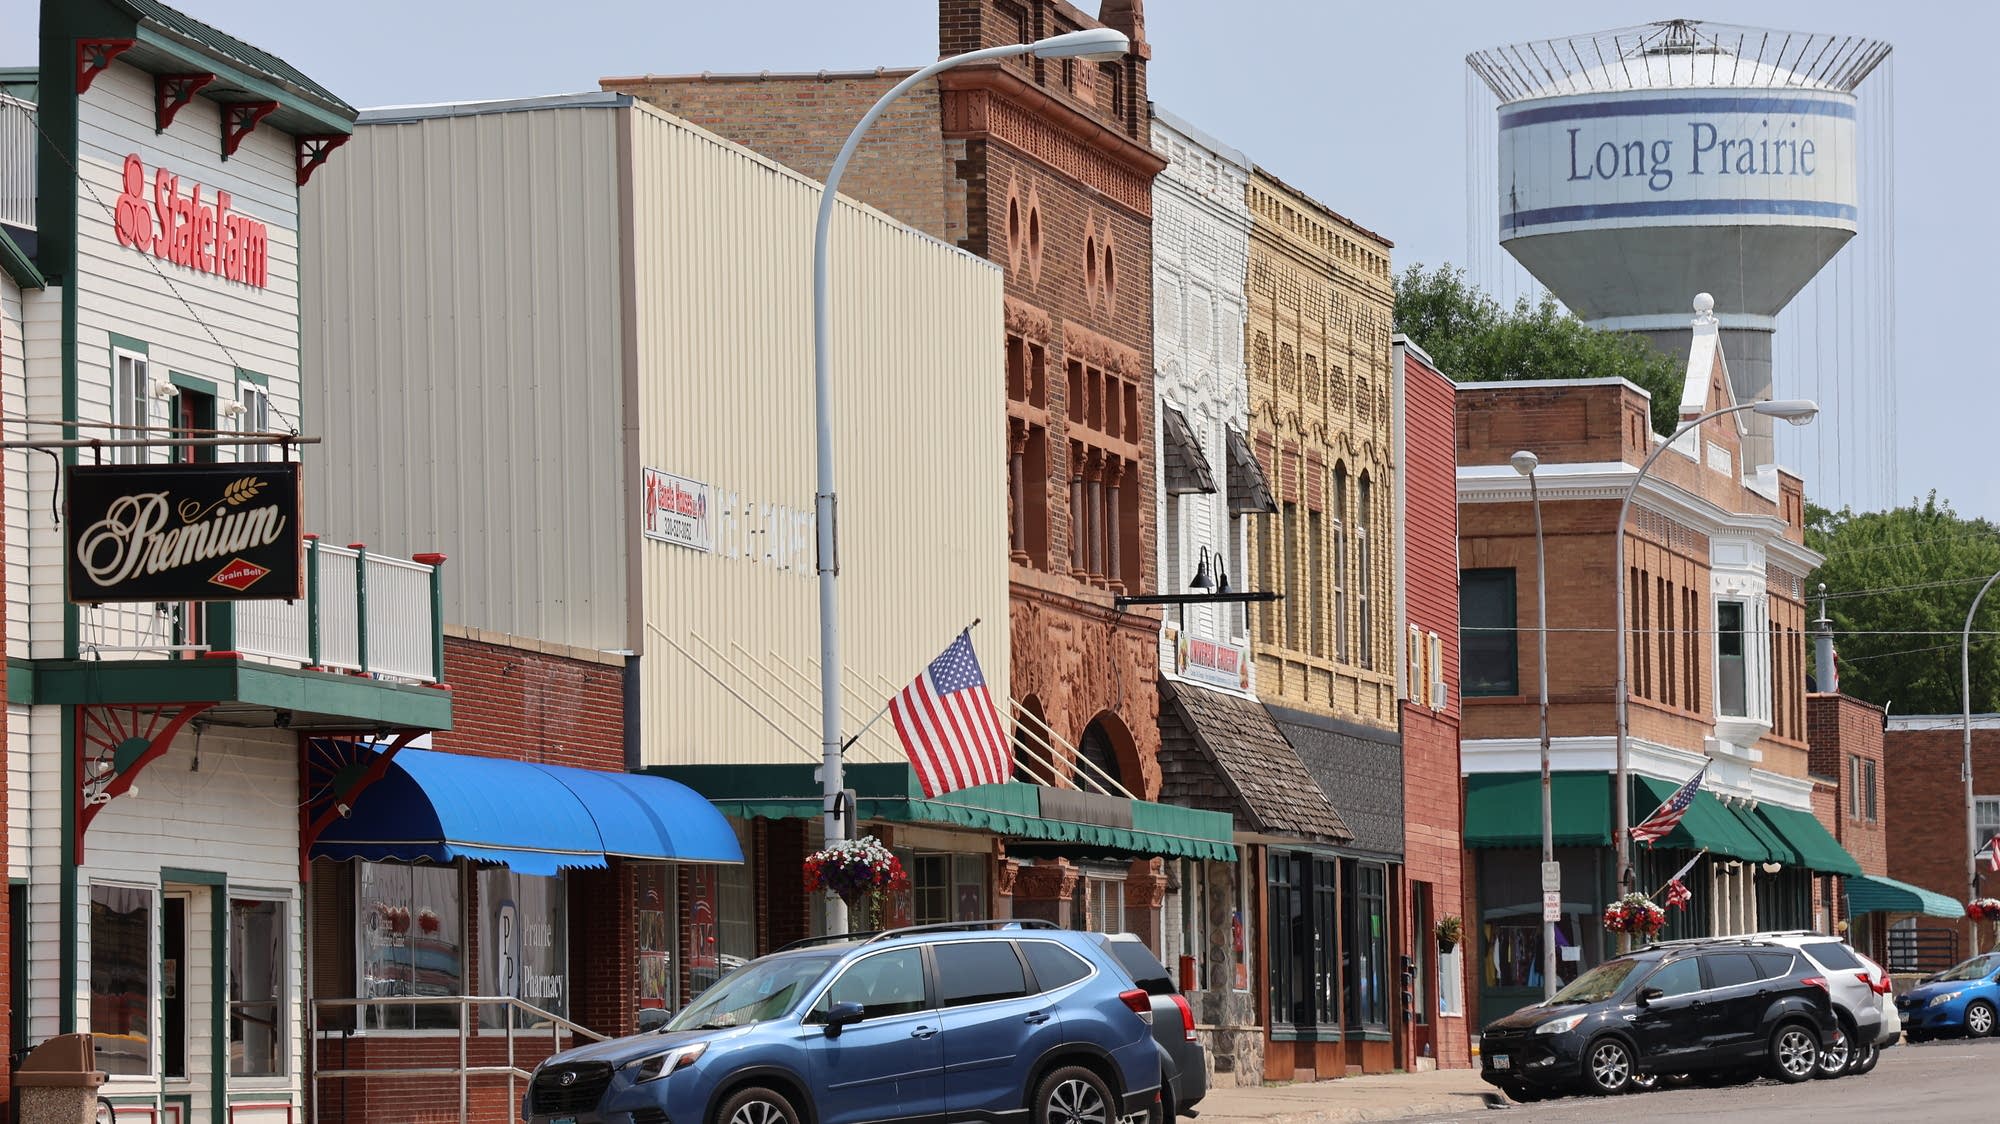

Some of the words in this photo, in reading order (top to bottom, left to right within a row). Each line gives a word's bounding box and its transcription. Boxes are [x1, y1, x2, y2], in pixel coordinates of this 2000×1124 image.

[1566, 128, 1674, 192] Long
[1687, 119, 1817, 177] Prairie
[153, 167, 213, 274] State
[214, 191, 268, 289] Farm
[77, 490, 286, 587] Premium
[217, 568, 243, 582] Grain
[243, 568, 262, 577] Belt
[503, 915, 510, 955] P
[523, 912, 552, 947] Prairie
[506, 956, 514, 996] P
[523, 965, 564, 1007] Pharmacy
